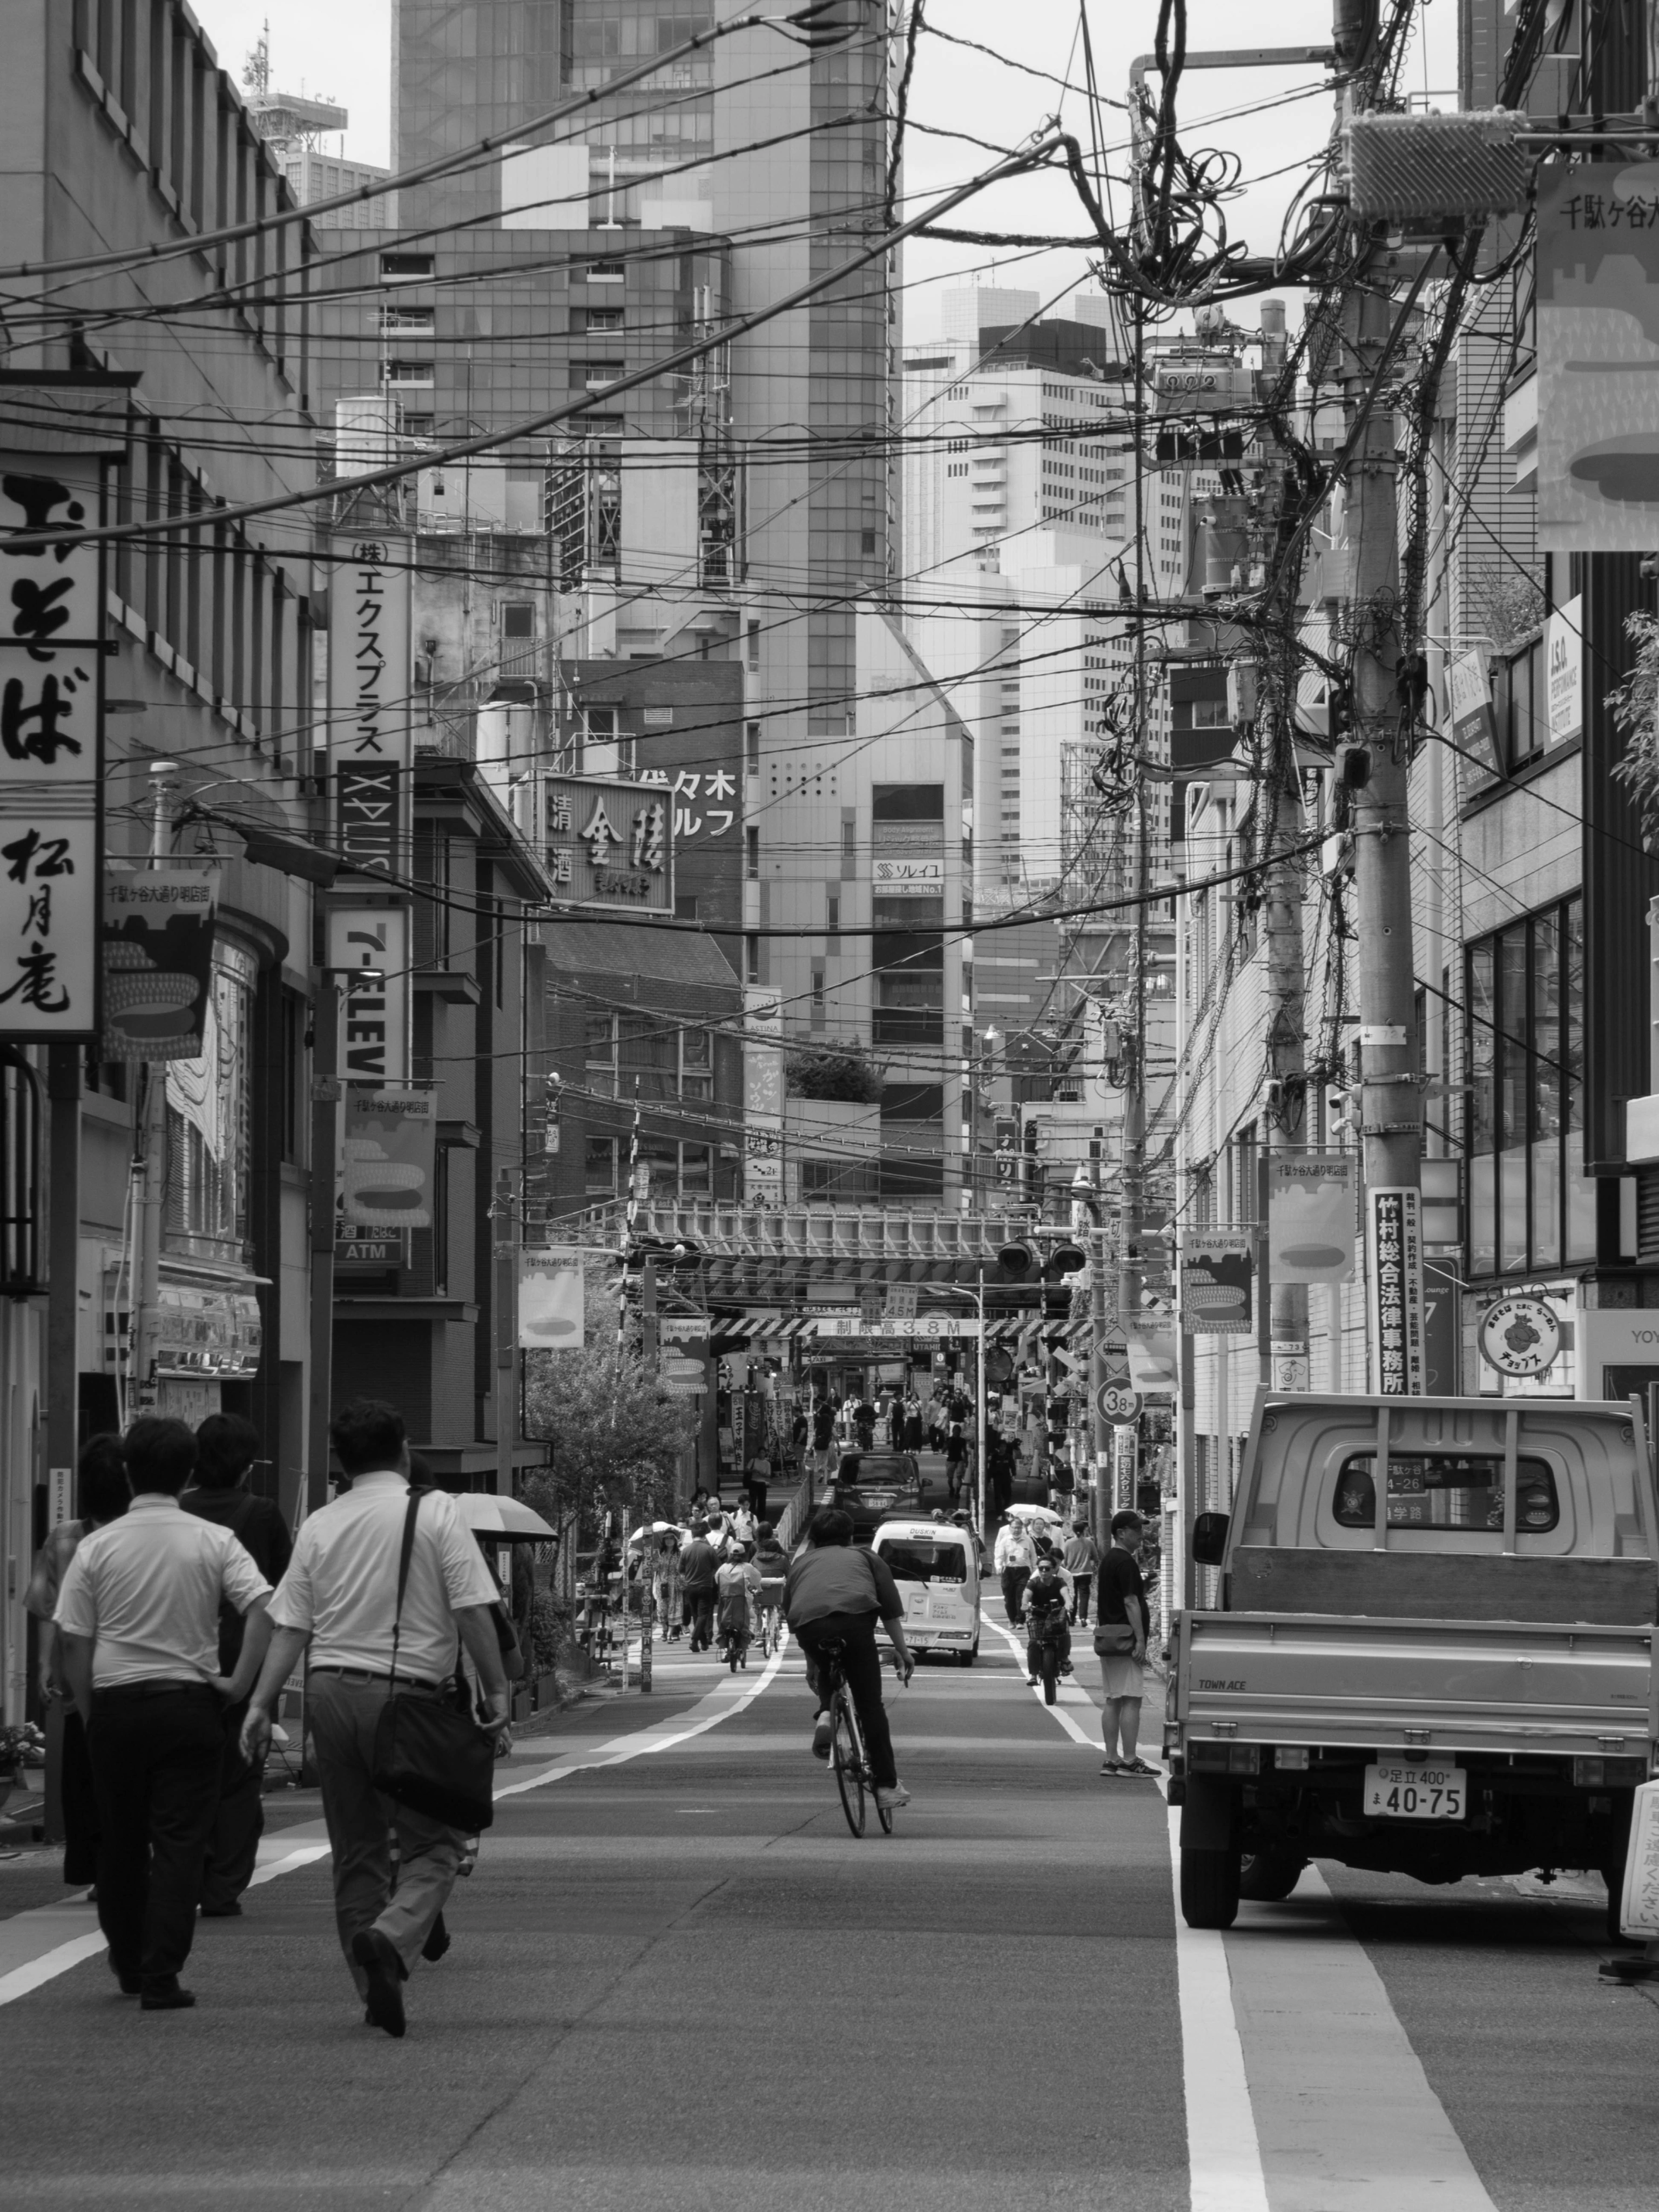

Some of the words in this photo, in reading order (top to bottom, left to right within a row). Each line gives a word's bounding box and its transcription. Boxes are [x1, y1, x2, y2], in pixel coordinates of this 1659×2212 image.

[548, 794, 572, 884] 清酒
[896, 865, 940, 878] ソレイユ
[766, 1166, 778, 1175] 2F
[346, 1244, 386, 1259] ATM
[1378, 1196, 1404, 1393] 竹村総合法律事務所
[1498, 1351, 1541, 1371] チョップス
[1388, 1479, 1419, 1489] 4-26
[1199, 1680, 1226, 1689] TOWN
[1226, 1681, 1246, 1690] ACE
[1390, 1769, 1417, 1784] 足立
[1419, 1771, 1445, 1785] 400
[1386, 1786, 1460, 1815] 40-75
